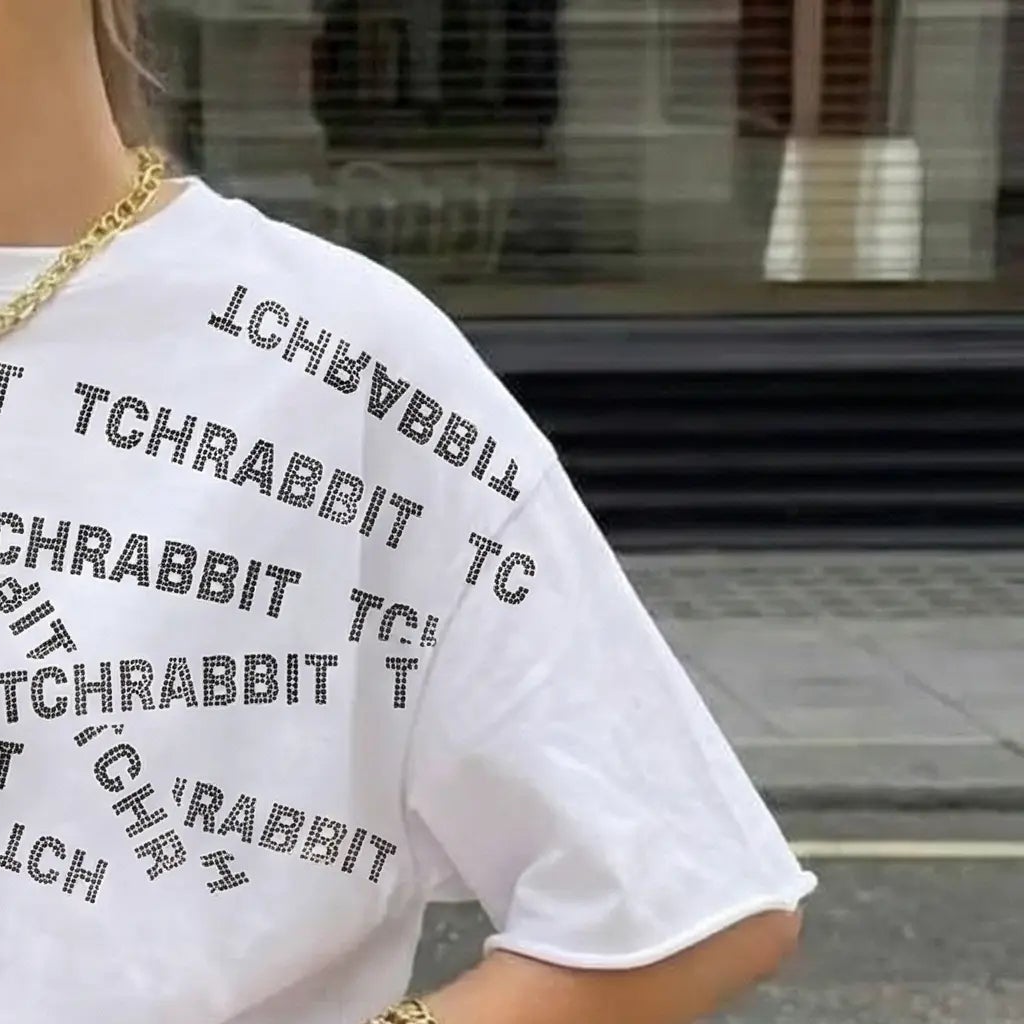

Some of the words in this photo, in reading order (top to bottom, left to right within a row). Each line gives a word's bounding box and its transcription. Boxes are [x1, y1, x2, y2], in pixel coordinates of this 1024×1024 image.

[74, 381, 424, 550] TCHRABBIT
[465, 531, 537, 605] TC
[385, 656, 420, 709] T
